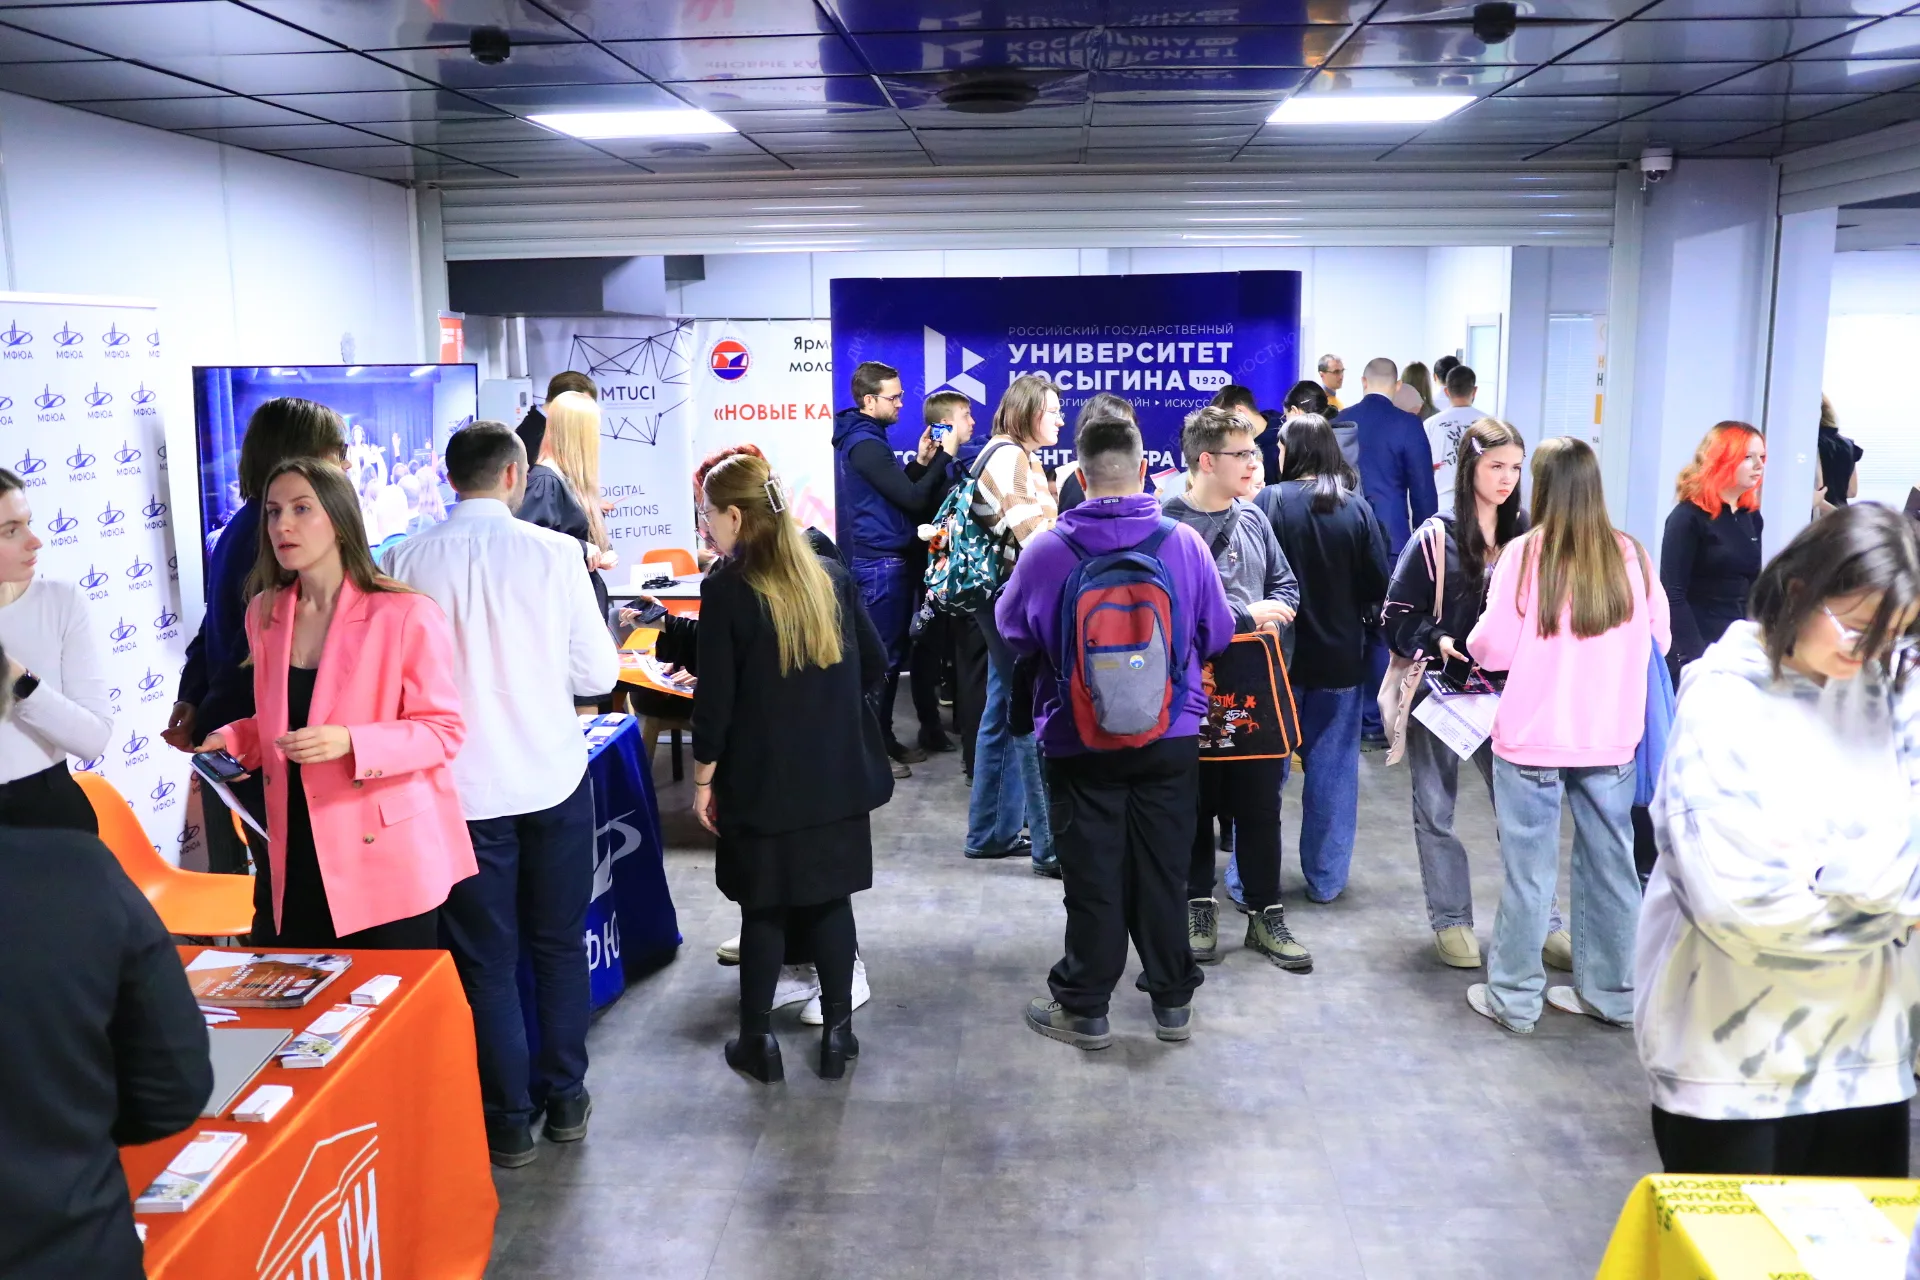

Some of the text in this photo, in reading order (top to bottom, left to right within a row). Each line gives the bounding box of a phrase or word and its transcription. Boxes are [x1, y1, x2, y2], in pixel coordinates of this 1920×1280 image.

[1008, 323, 1234, 336] РОССИЙСКИЙ ГОСУДАРСТВЕННЫЙ
[794, 336, 831, 353] Ярм
[4, 351, 33, 360] МФЮА
[56, 350, 83, 360] МФЮА
[104, 350, 130, 359] МФЮА
[1008, 342, 1233, 363] УНИВЕРСИТЕТ
[1009, 370, 1226, 391] КОСЫГИНА 1920
[601, 385, 656, 401] MTUCI
[37, 413, 65, 422] МФЮА
[87, 410, 113, 419] МФЮА
[133, 408, 156, 416] МФЮА
[714, 403, 797, 421] «НОВЫЕ
[69, 472, 96, 482] МФЮА
[116, 467, 141, 476] МФЮА
[600, 485, 646, 497] DIGITAL
[144, 520, 167, 530] МФЮА
[625, 524, 672, 538] FUTURE
[100, 528, 125, 538] МФЮА
[51, 536, 78, 546] МФЮА
[129, 580, 153, 591] МФЮА
[156, 630, 178, 642] МФЮА
[113, 641, 137, 655] МФЮА
[140, 691, 164, 704] МФЮА
[125, 753, 149, 768] МФЮА
[153, 798, 176, 814] МФЮА
